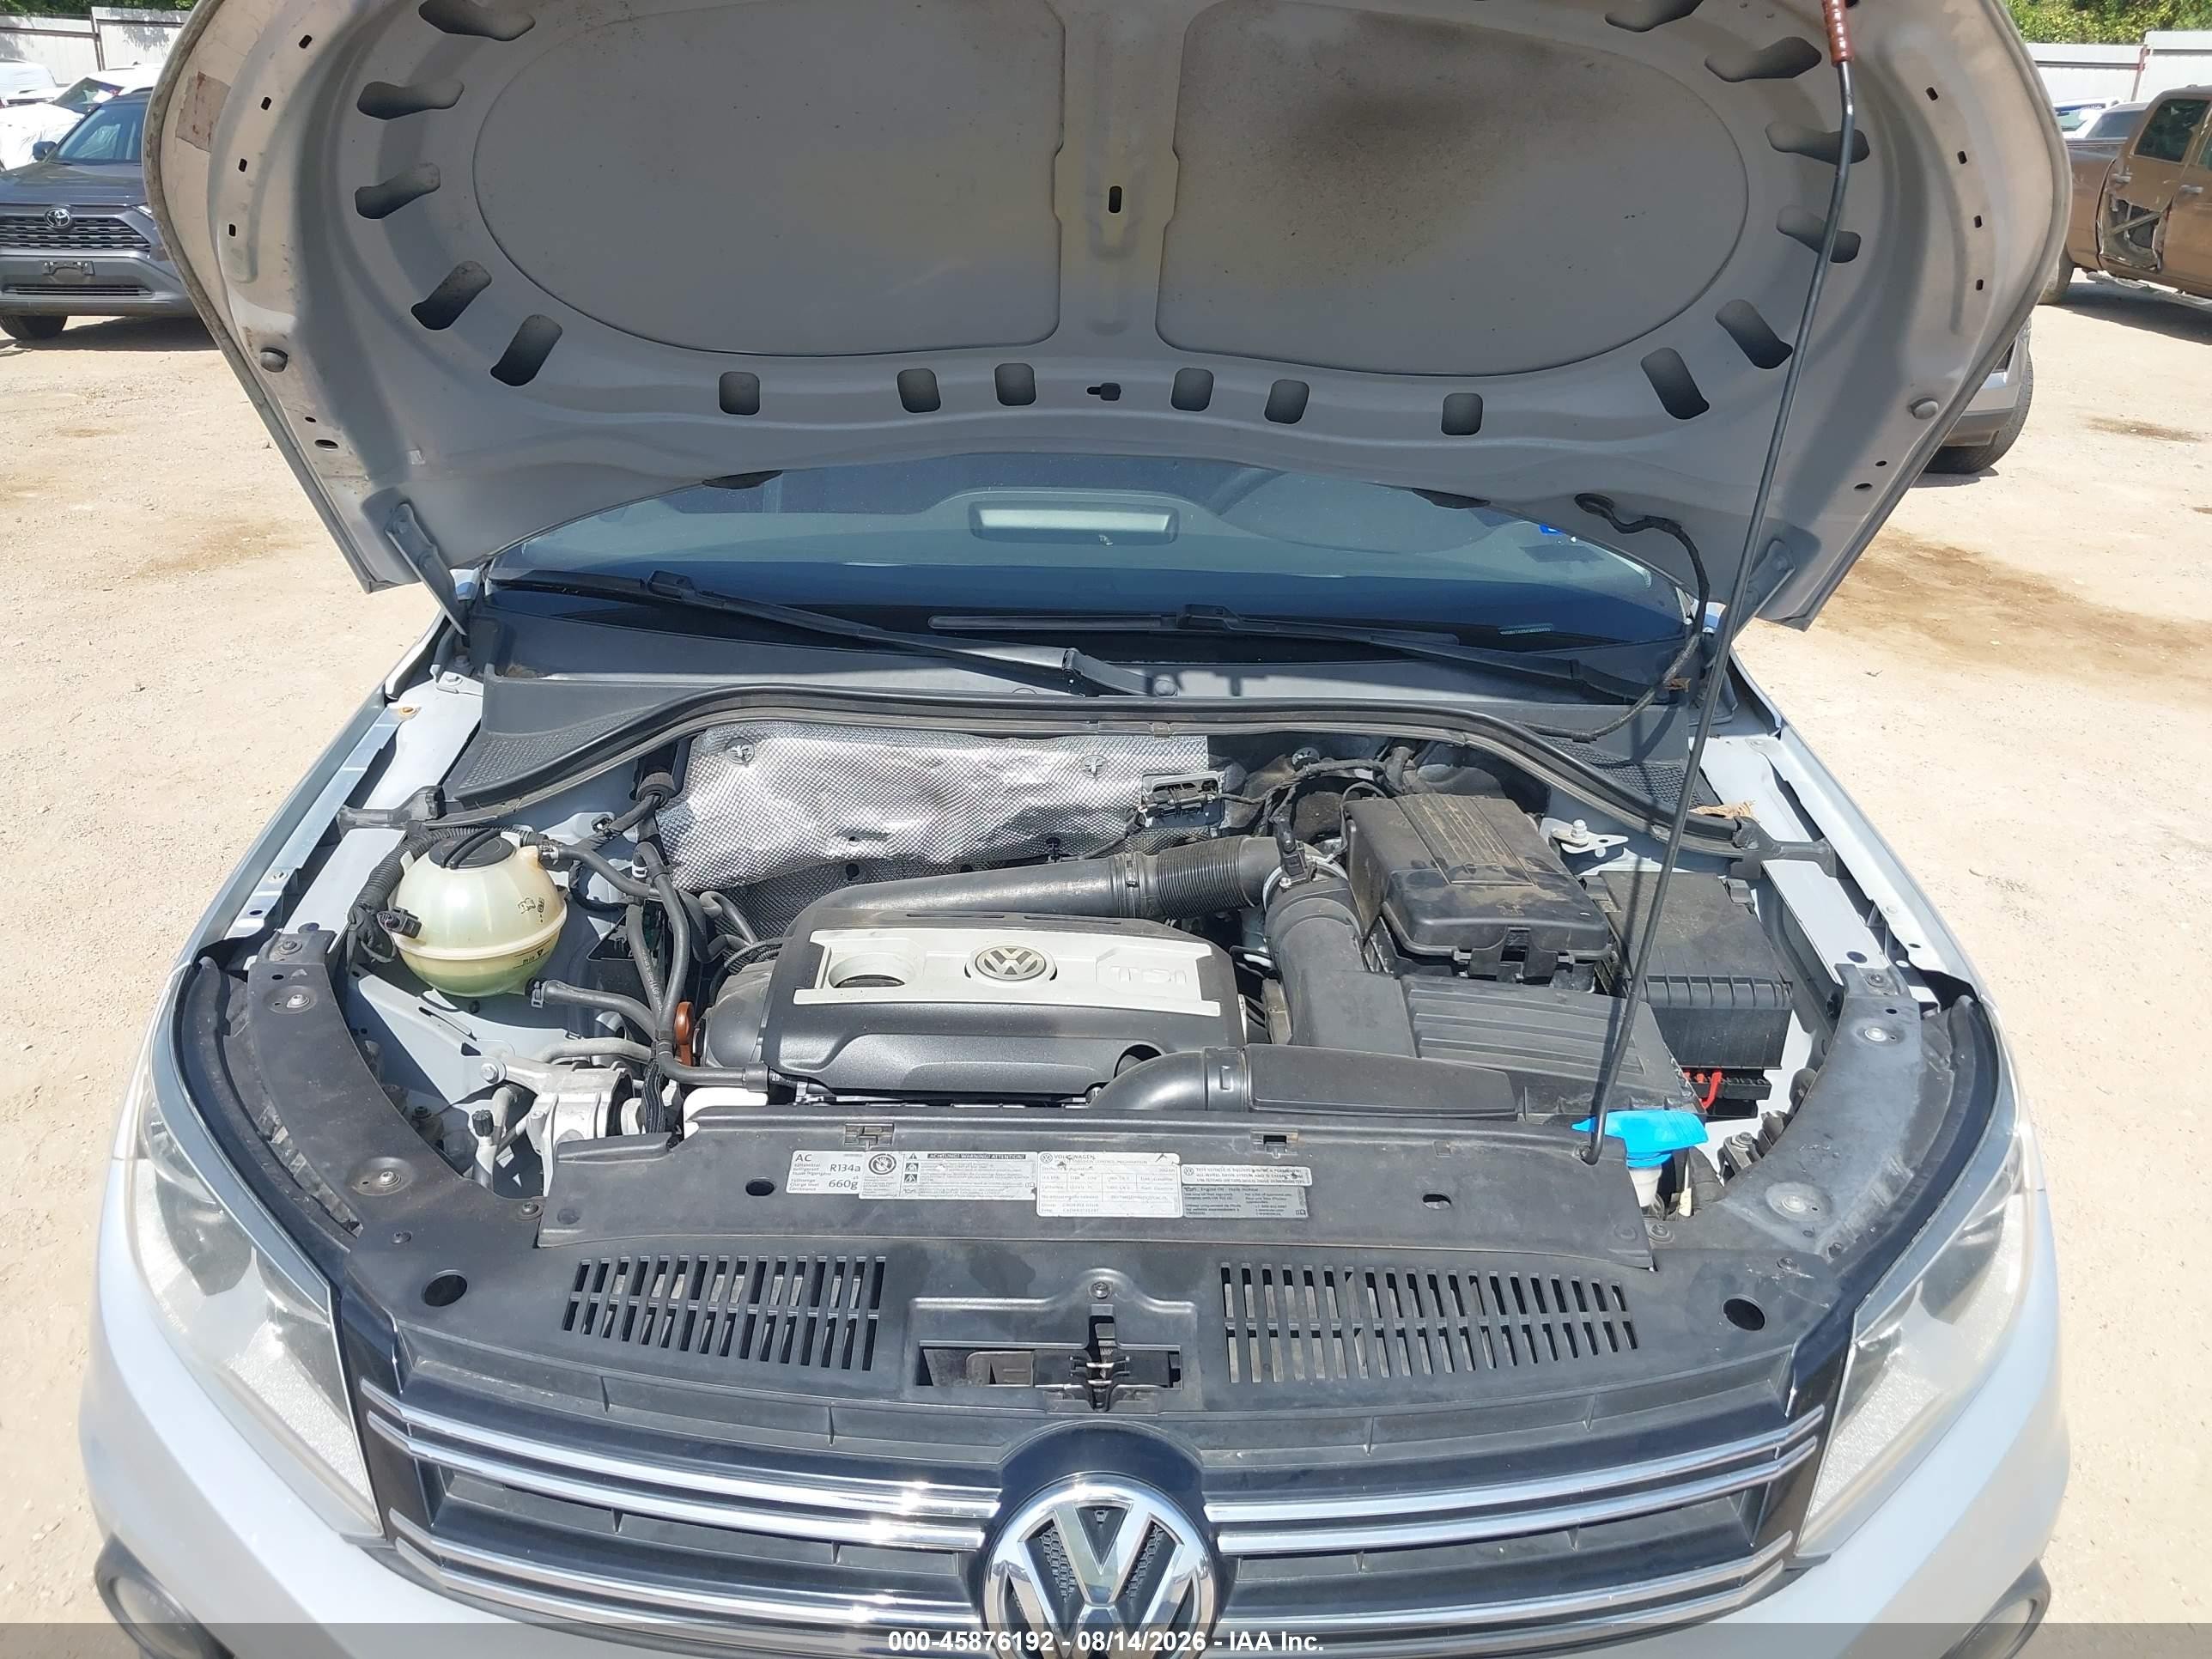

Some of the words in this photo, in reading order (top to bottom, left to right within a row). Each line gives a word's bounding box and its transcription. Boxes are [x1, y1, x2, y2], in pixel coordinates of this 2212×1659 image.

[523, 956, 535, 964] min
[795, 1153, 812, 1162] AC
[830, 1164, 860, 1172] R134a
[828, 1179, 859, 1191] 660g
